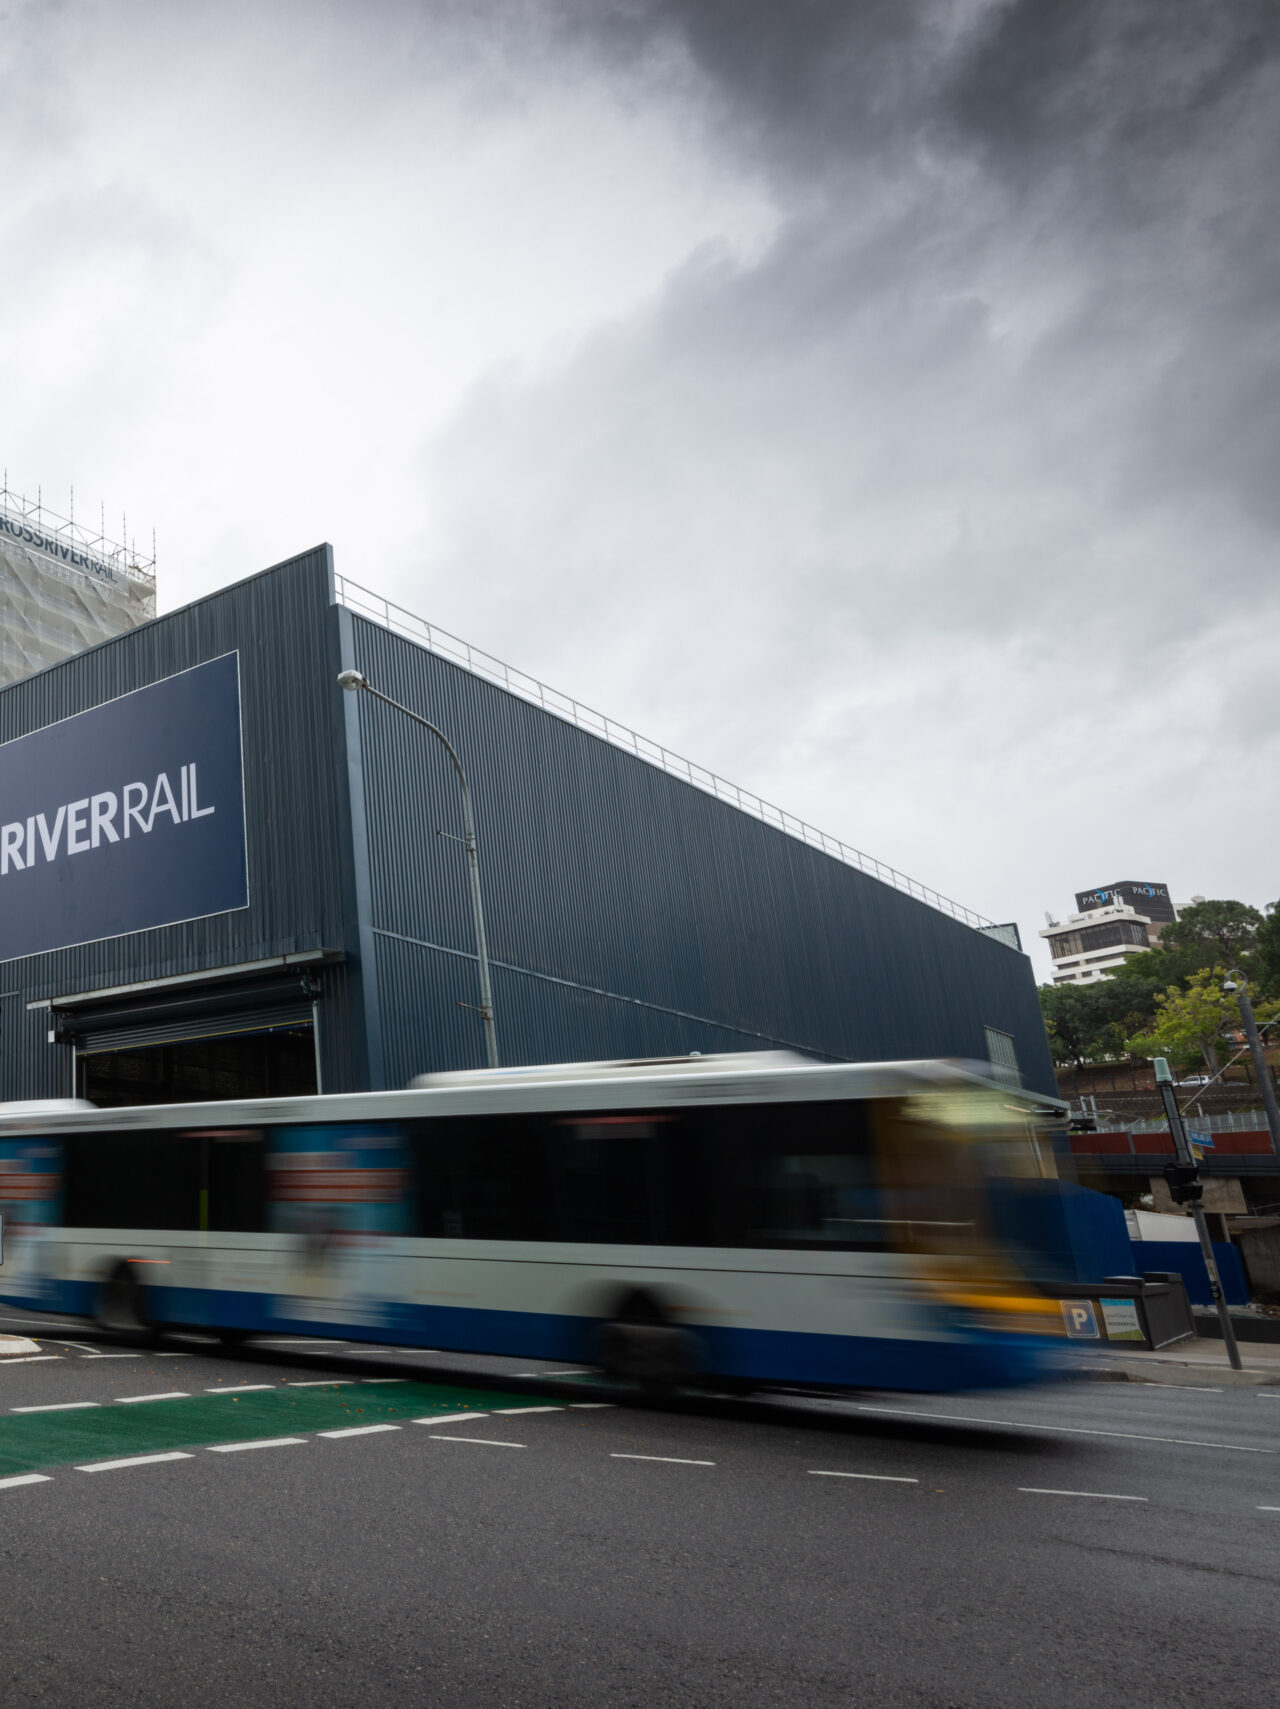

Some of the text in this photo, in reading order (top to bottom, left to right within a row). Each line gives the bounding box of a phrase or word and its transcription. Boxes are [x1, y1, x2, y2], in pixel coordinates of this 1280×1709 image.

[1082, 888, 1121, 904] PACIFIC
[1132, 886, 1167, 897] PACIFIC
[1071, 1308, 1087, 1329] P
